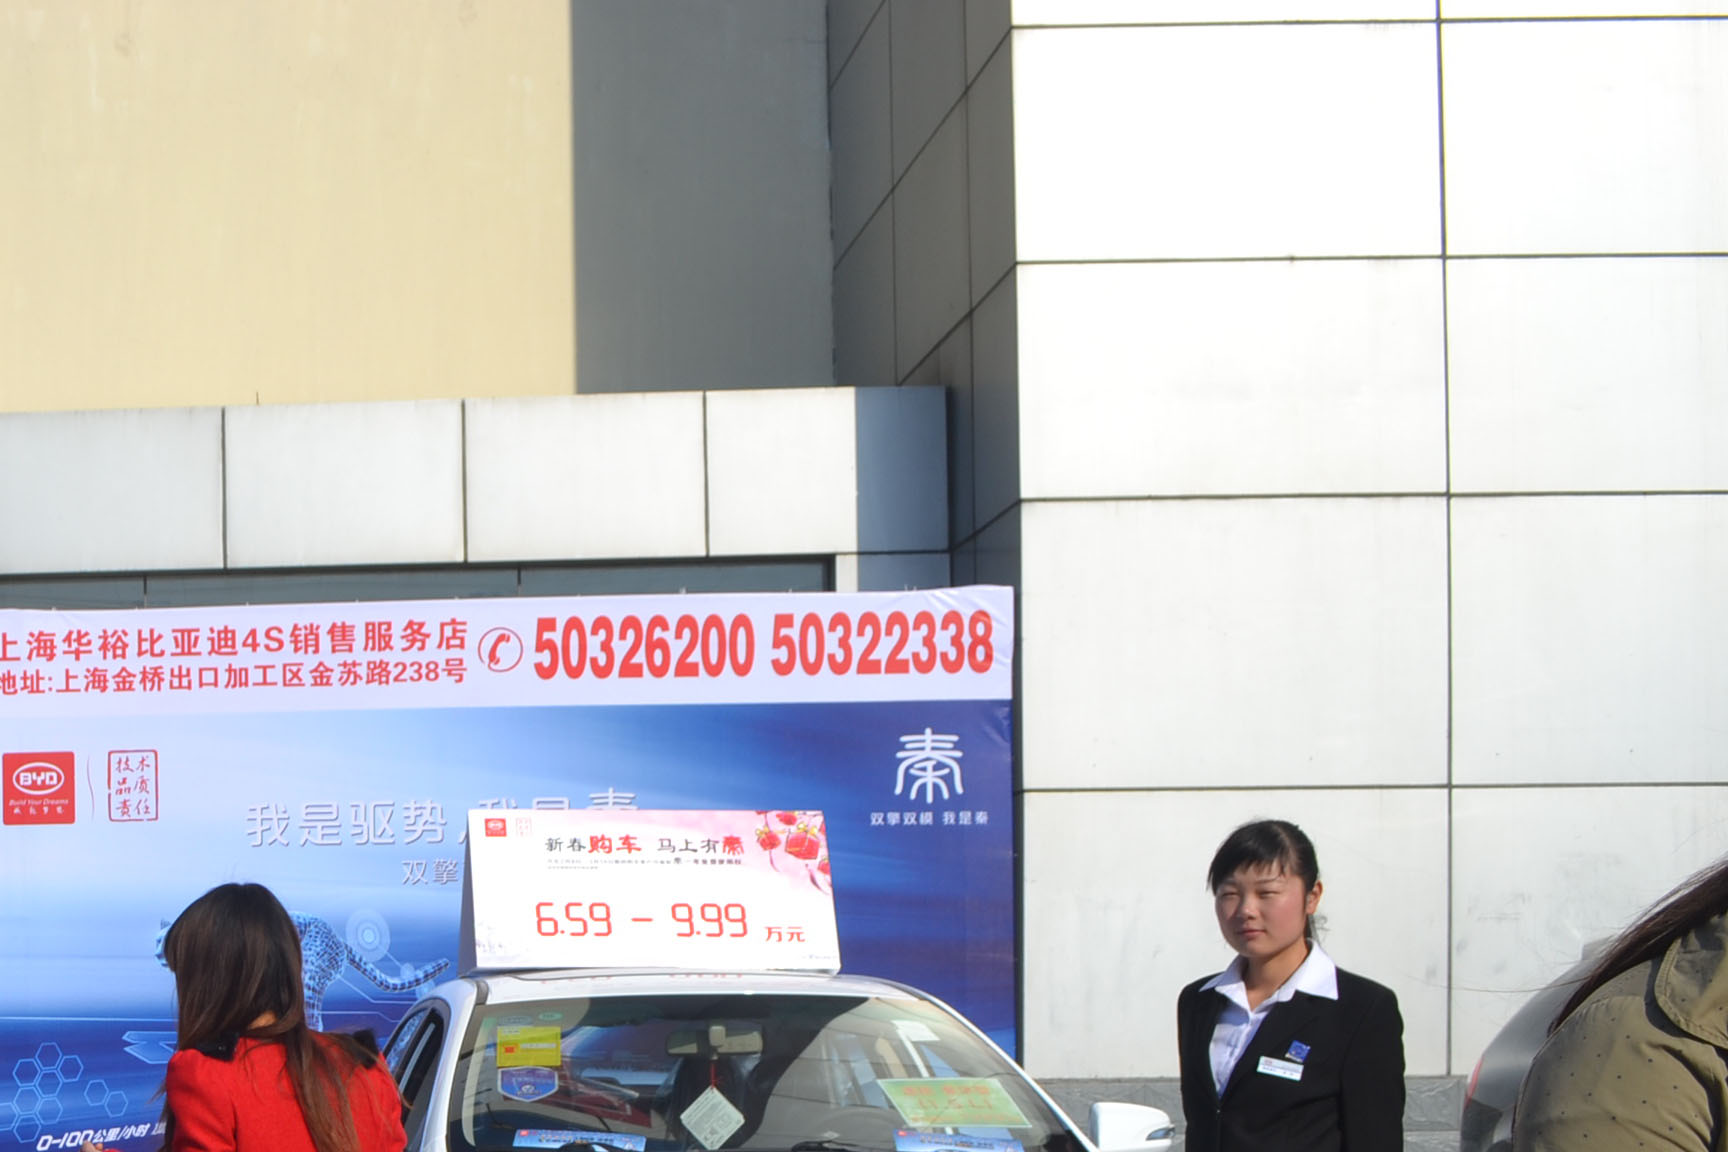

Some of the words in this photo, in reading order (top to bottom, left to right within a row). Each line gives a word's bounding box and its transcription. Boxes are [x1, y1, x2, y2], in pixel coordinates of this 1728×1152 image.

[533, 613, 755, 680] 50326200
[771, 610, 994, 676] 50322338
[115, 755, 151, 773] 技术
[894, 727, 964, 804] 秦
[20, 771, 58, 786] BYD
[115, 775, 151, 795] 品质
[116, 799, 151, 818] 责任
[545, 834, 642, 854] 新春购车
[535, 902, 613, 937] 6.59
[671, 903, 748, 938] 9.99
[764, 926, 807, 943] 万元
